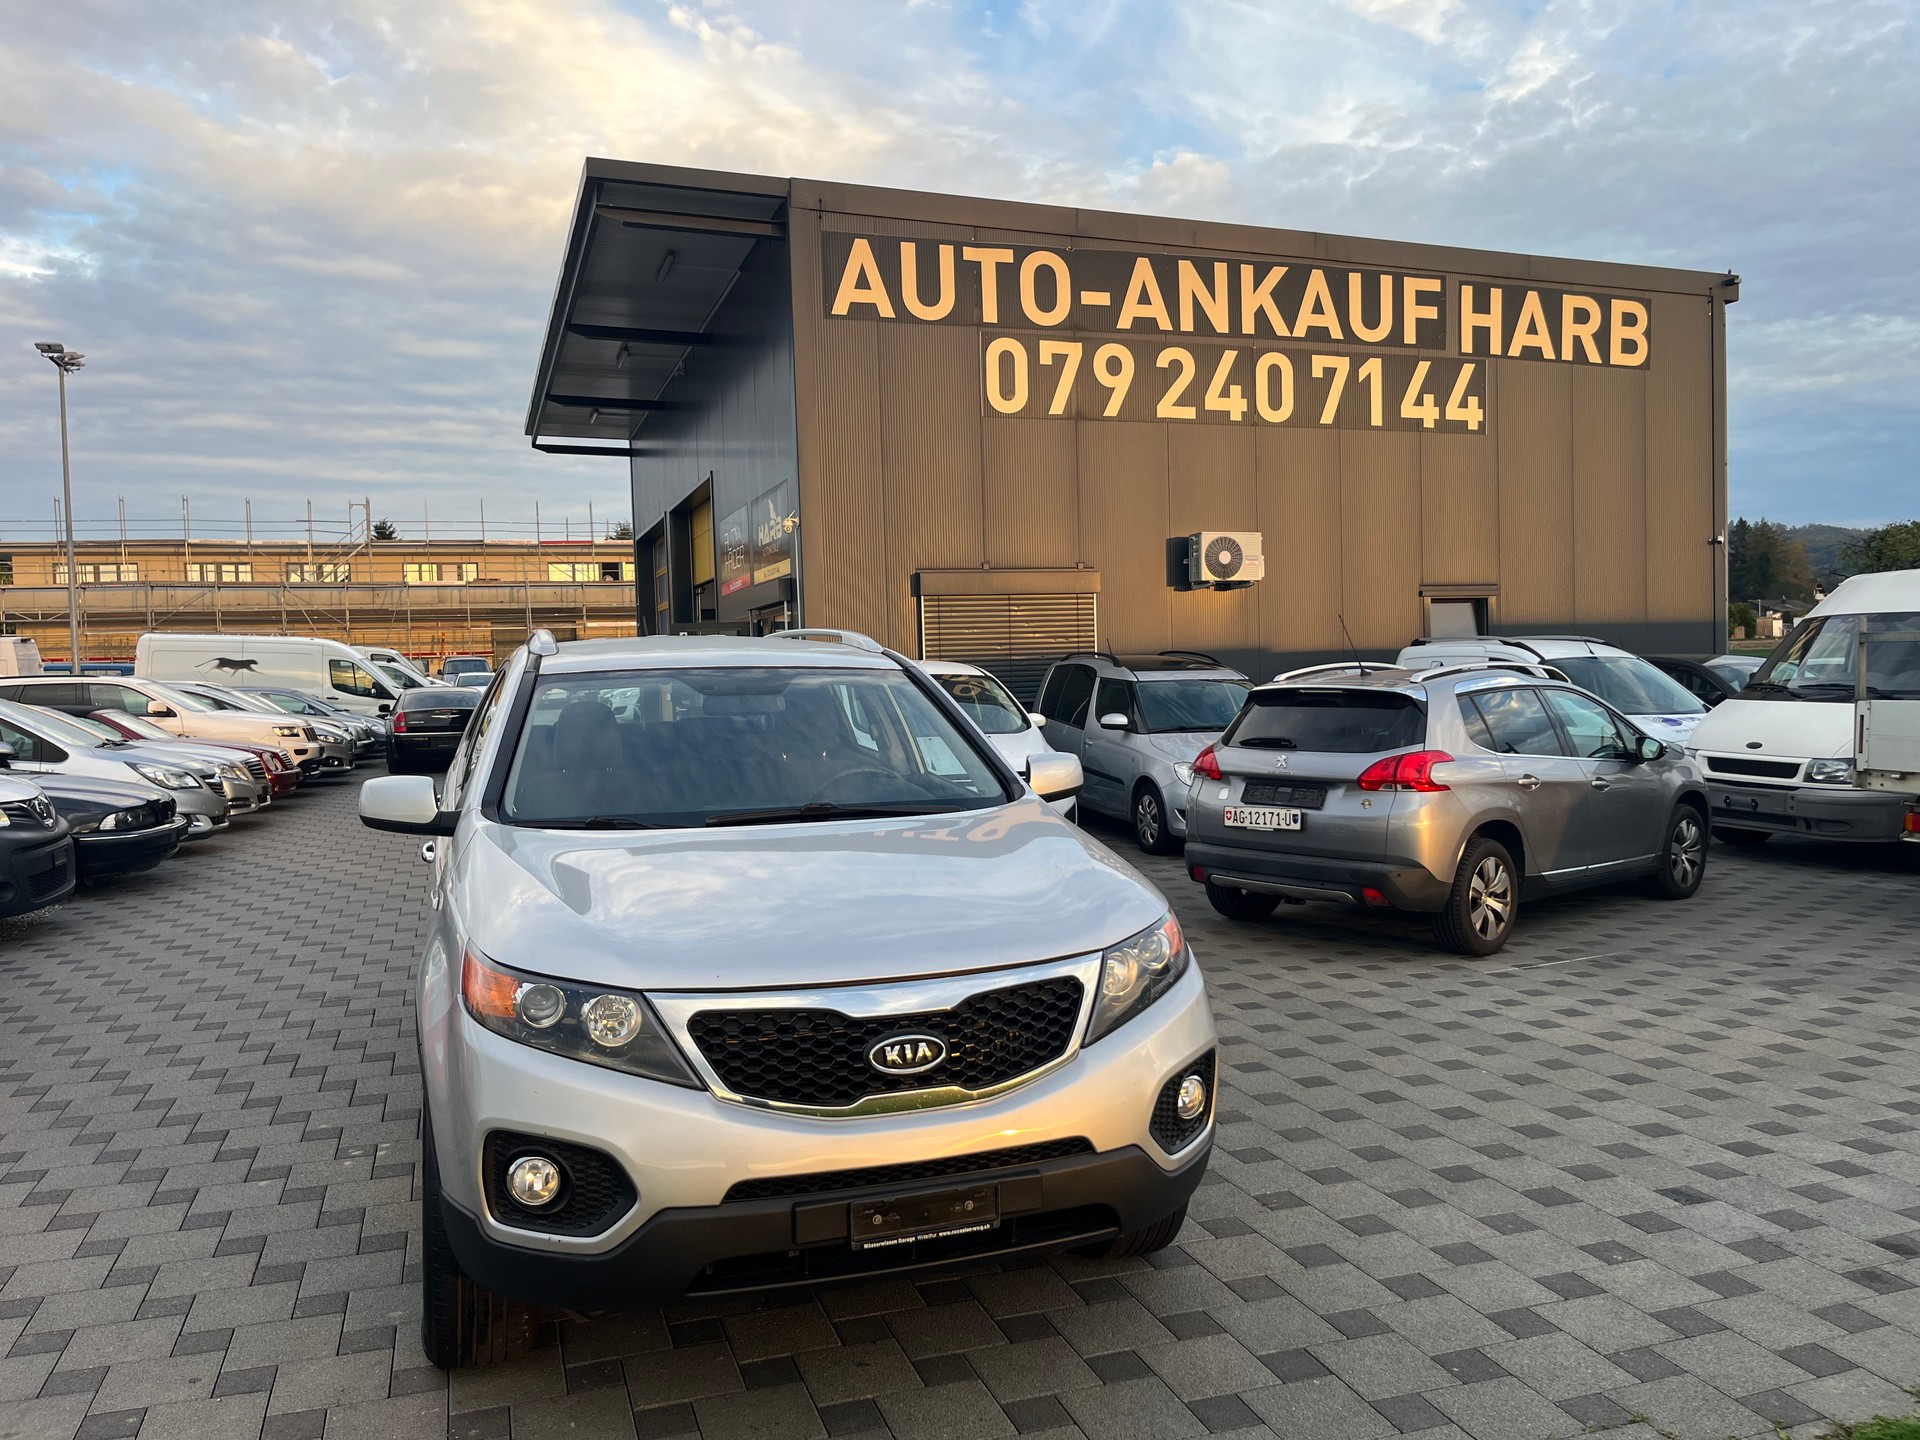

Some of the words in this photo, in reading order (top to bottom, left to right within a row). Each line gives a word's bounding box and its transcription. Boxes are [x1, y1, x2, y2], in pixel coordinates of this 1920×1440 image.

[831, 238, 1441, 345] AUTO-ANKAUF
[1461, 285, 1650, 367] HARB
[985, 337, 1135, 417] 079
[1156, 346, 1294, 423] 240
[758, 515, 782, 547] HARB
[884, 1042, 932, 1065] KIA
